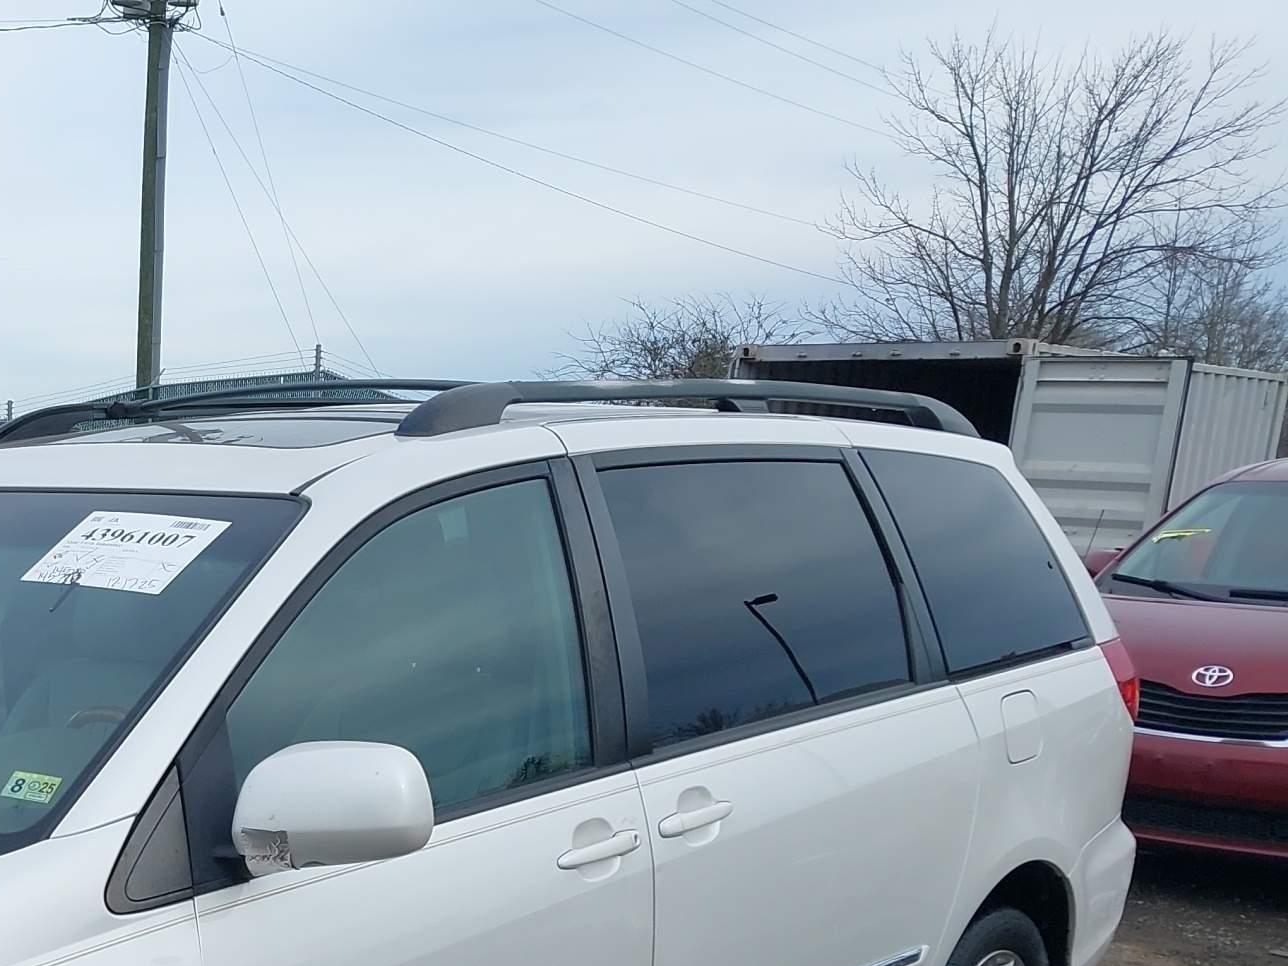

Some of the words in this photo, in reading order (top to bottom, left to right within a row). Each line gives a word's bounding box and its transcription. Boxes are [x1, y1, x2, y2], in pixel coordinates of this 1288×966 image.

[81, 527, 198, 549] 43961007
[10, 778, 26, 794] 8
[38, 782, 57, 795] 25
